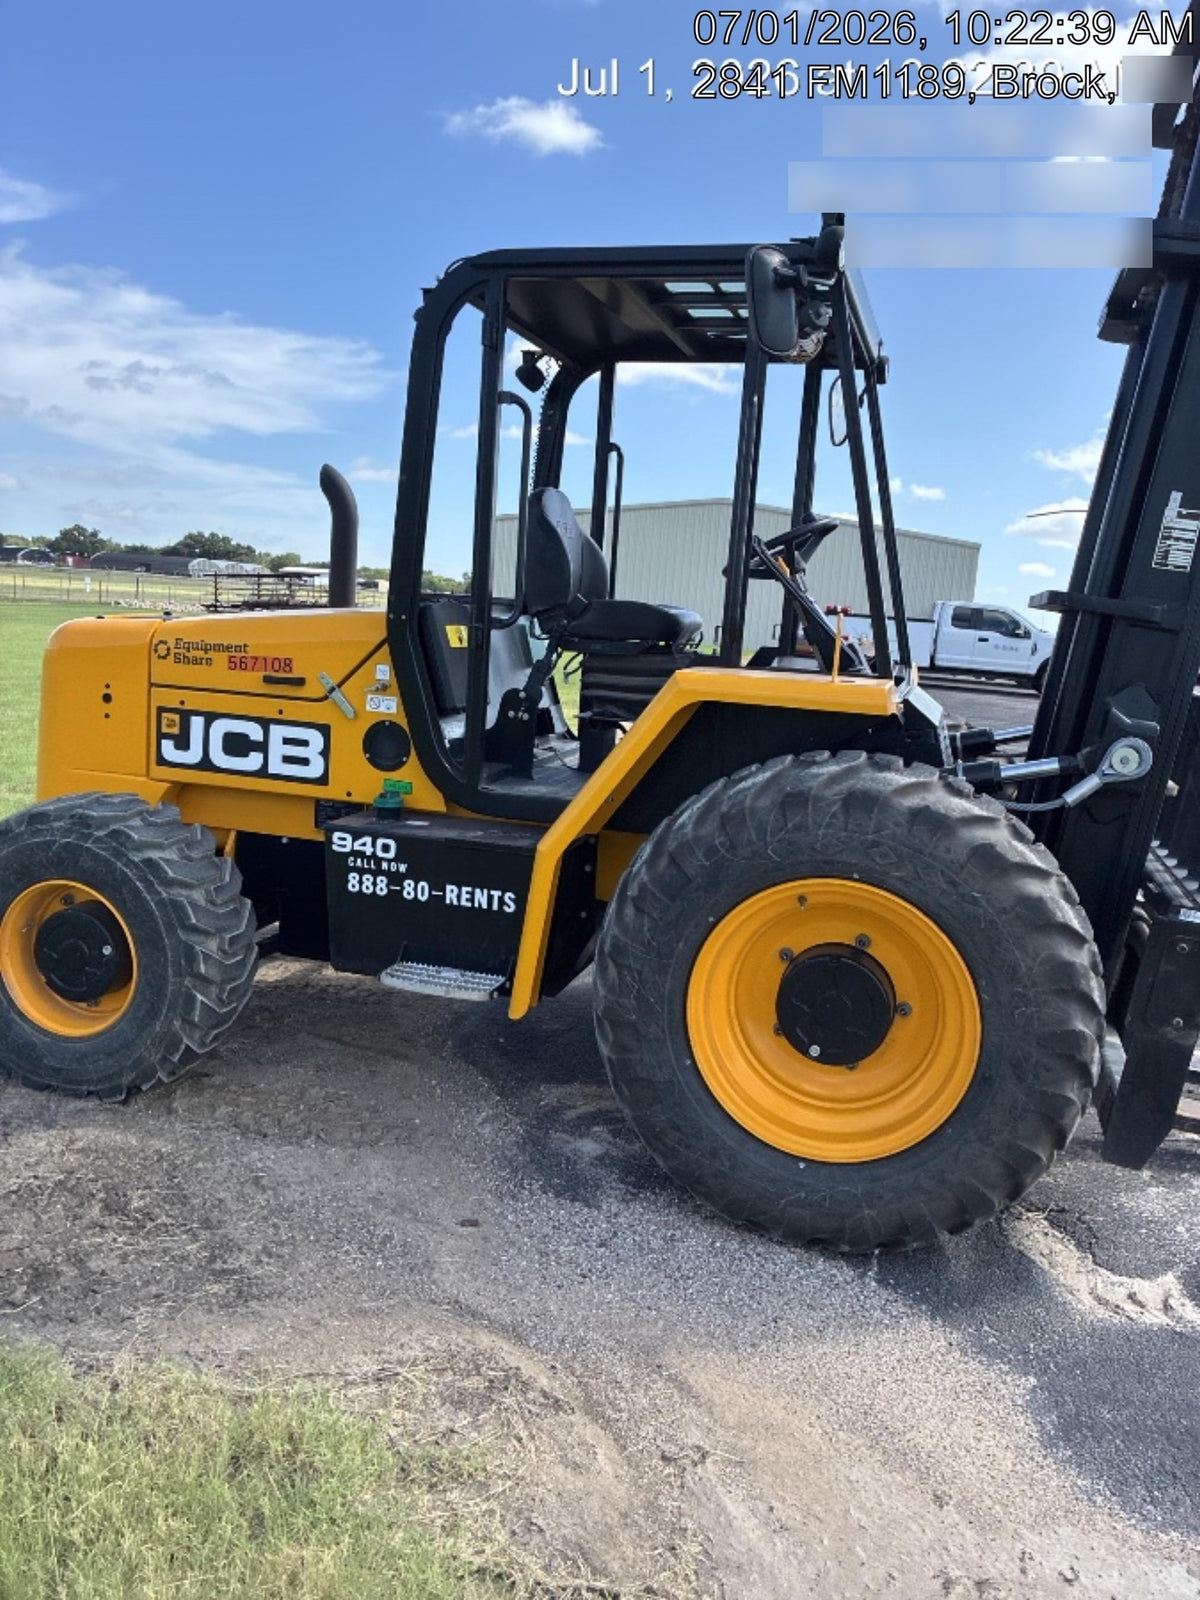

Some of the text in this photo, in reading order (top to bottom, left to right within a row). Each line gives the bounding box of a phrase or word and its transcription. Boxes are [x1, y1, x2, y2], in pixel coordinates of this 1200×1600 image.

[174, 638, 249, 654] Equipment
[174, 652, 213, 666] Share
[228, 655, 293, 673] 567108
[161, 716, 325, 779] JCB
[332, 831, 397, 859] 940
[348, 857, 408, 873] CALL NOW
[347, 872, 517, 913] 888-80-RENTS
